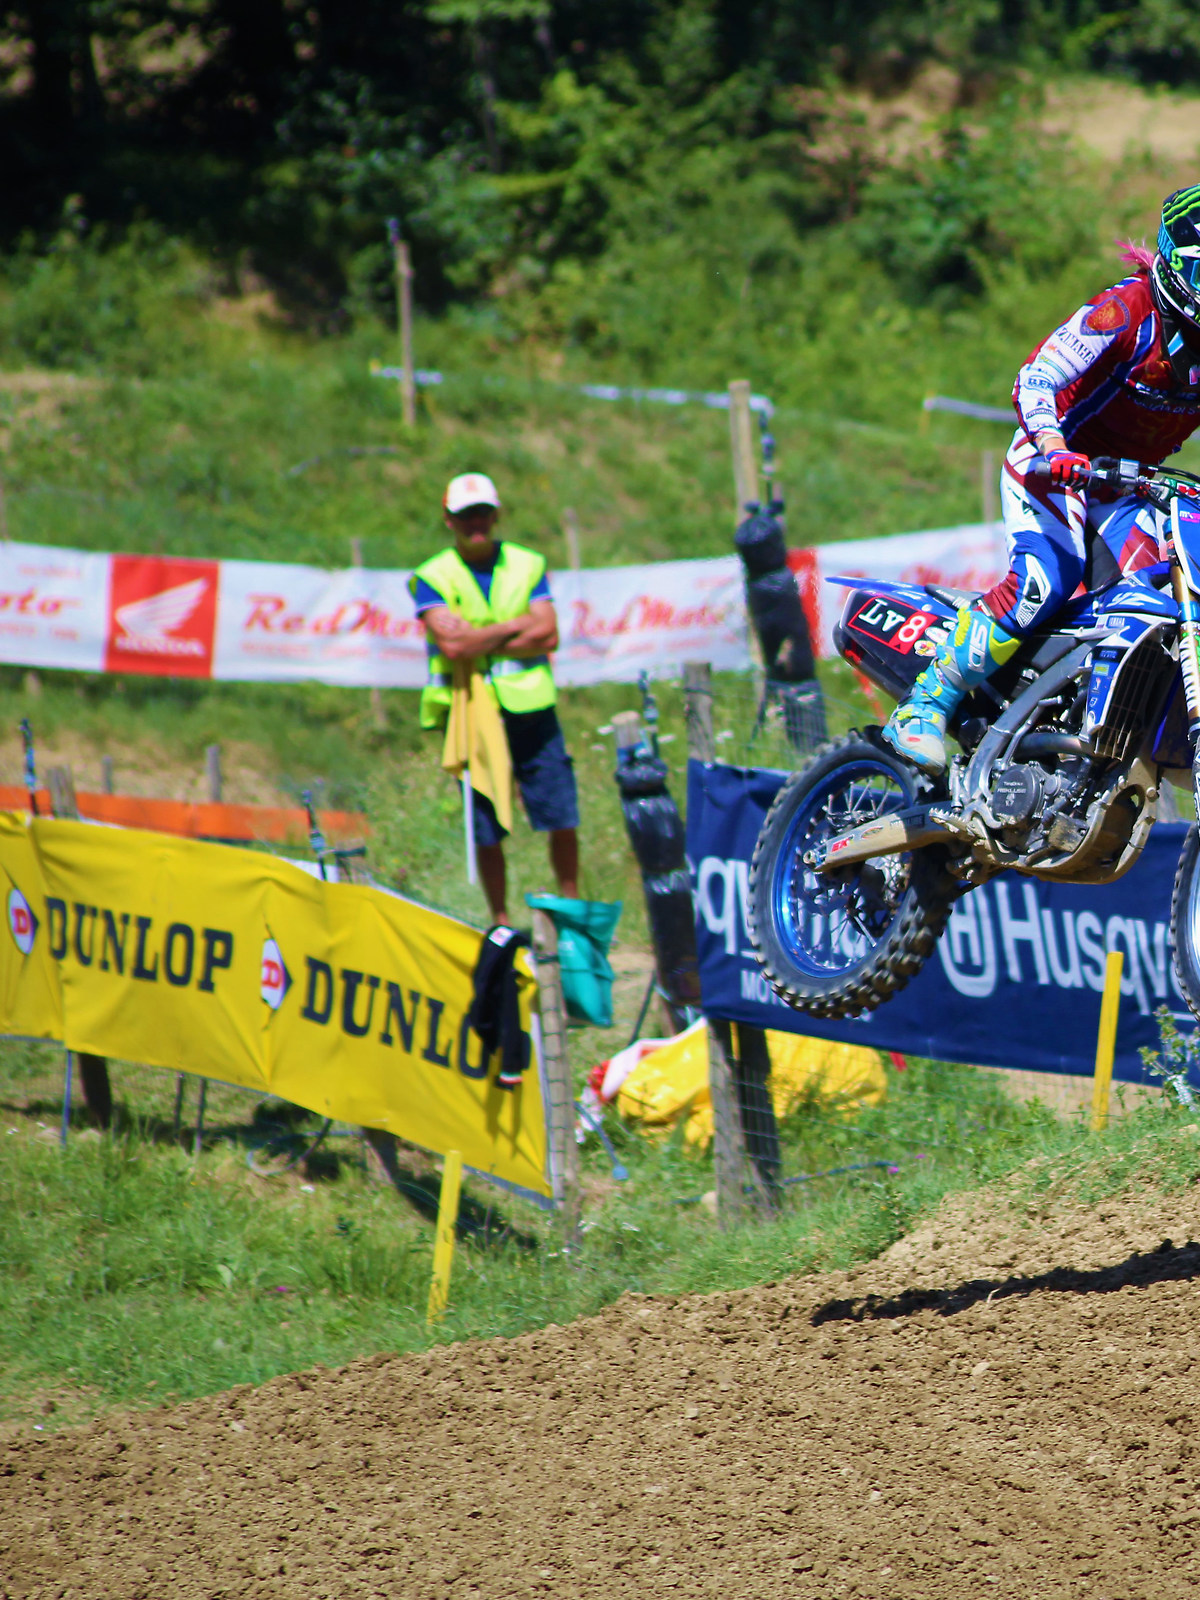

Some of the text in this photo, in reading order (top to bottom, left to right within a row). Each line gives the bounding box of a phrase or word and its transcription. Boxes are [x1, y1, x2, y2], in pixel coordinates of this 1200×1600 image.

[1054, 327, 1096, 364] YAMAHA
[44, 894, 234, 995] DUNLOP
[299, 954, 495, 1081] DUNLO
